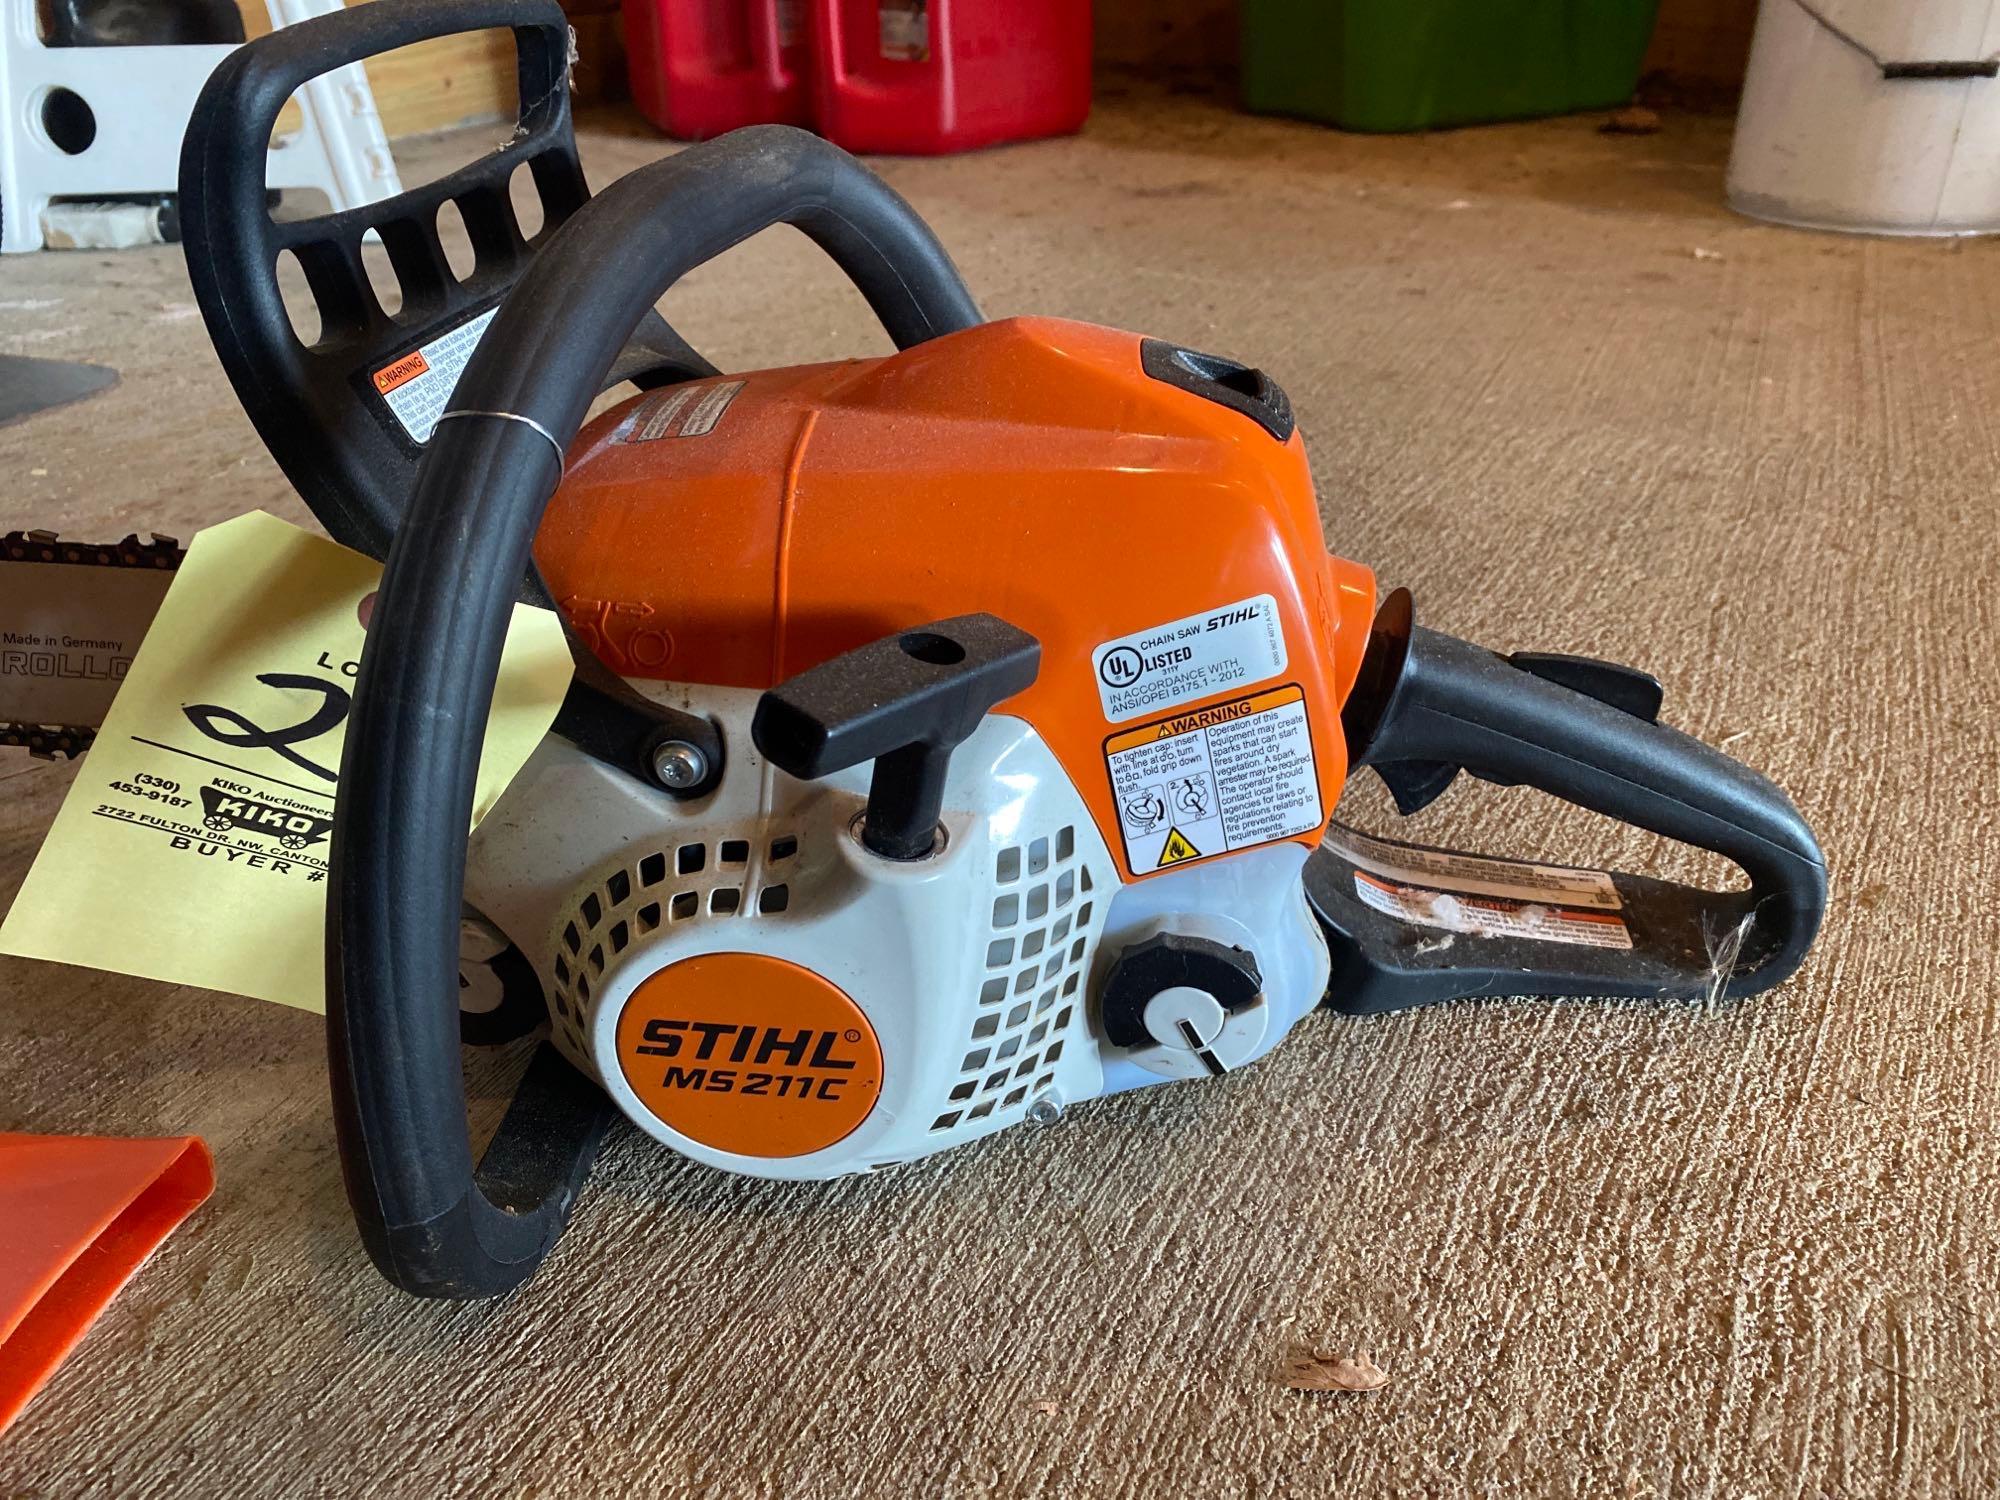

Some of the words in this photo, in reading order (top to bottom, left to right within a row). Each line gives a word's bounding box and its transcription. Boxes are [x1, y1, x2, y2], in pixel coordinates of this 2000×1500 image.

[385, 356, 423, 384] WARNING
[3, 632, 40, 646] Made
[45, 635, 57, 646] in
[62, 635, 123, 651] Germany
[1139, 631, 1175, 651] CHAIN
[1177, 624, 1201, 640] SAW
[2, 650, 133, 681] ROLLO
[317, 652, 359, 677] LO
[1143, 646, 1193, 673] LISTED
[1162, 666, 1179, 676] 311Y
[1109, 693, 1122, 705] IN
[1123, 667, 1205, 701] ACCORDANCE
[1208, 657, 1239, 674] WITH
[1111, 689, 1171, 715] ANSI/OPEI
[1173, 678, 1209, 697] B175.1
[1218, 667, 1246, 684] 2012
[1171, 701, 1252, 734] WARNING
[1209, 719, 1251, 738] Operation
[1252, 715, 1262, 725] of
[1263, 711, 1279, 721] this
[1210, 727, 1256, 748] equipment
[1257, 723, 1275, 734] may
[1277, 715, 1304, 729] create
[1111, 756, 1122, 765] To
[1124, 746, 1153, 763] tighten
[1154, 742, 1174, 755] cap:
[1174, 734, 1199, 747] insert
[1212, 742, 1241, 758] sparks
[1242, 736, 1260, 748] that
[1261, 734, 1277, 744] can
[1279, 727, 1299, 739] start
[1214, 756, 1233, 767] fires
[1234, 747, 1265, 761] around
[1266, 743, 1280, 754] dry
[1113, 763, 1132, 775] with
[1133, 758, 1149, 769] line
[1149, 755, 1160, 765] at
[1115, 775, 1124, 785] to
[1143, 765, 1159, 776] fold
[1160, 760, 1178, 773] grip
[1179, 753, 1202, 766] down
[1216, 758, 1263, 777] vegetation.
[1264, 755, 1272, 763] A
[1272, 748, 1296, 762] spark
[1218, 772, 1248, 787] arrester
[1249, 767, 1266, 779] may
[1267, 764, 1278, 774] be
[109, 781, 192, 809] 453-9187
[134, 773, 180, 794] (330)
[1117, 781, 1140, 794] flush.
[1170, 781, 1179, 790] 2.
[1219, 785, 1237, 796] The
[1238, 776, 1274, 792] operator
[1275, 766, 1304, 781] should
[1221, 790, 1252, 806] contact
[1253, 785, 1274, 797] local
[1275, 781, 1290, 791] fire
[211, 777, 251, 795] KIKO
[254, 791, 334, 818] Auctioneers
[1223, 799, 1261, 815] agencies
[1262, 794, 1275, 804] for
[1276, 789, 1296, 800] laws
[1297, 786, 1306, 795] or
[1225, 805, 1272, 824] regulations
[1272, 797, 1304, 812] relating
[1305, 794, 1314, 803] to
[97, 804, 135, 820] 2722
[139, 814, 202, 836] FULTON
[206, 831, 232, 844] DR.
[237, 839, 264, 852] NW,
[215, 797, 315, 834] KIKO
[1226, 823, 1240, 833] fire
[1242, 812, 1286, 829] prevention
[1228, 823, 1286, 842] requirements.
[170, 835, 291, 875] BUYER
[306, 871, 325, 882] #
[662, 1067, 738, 1092] MS
